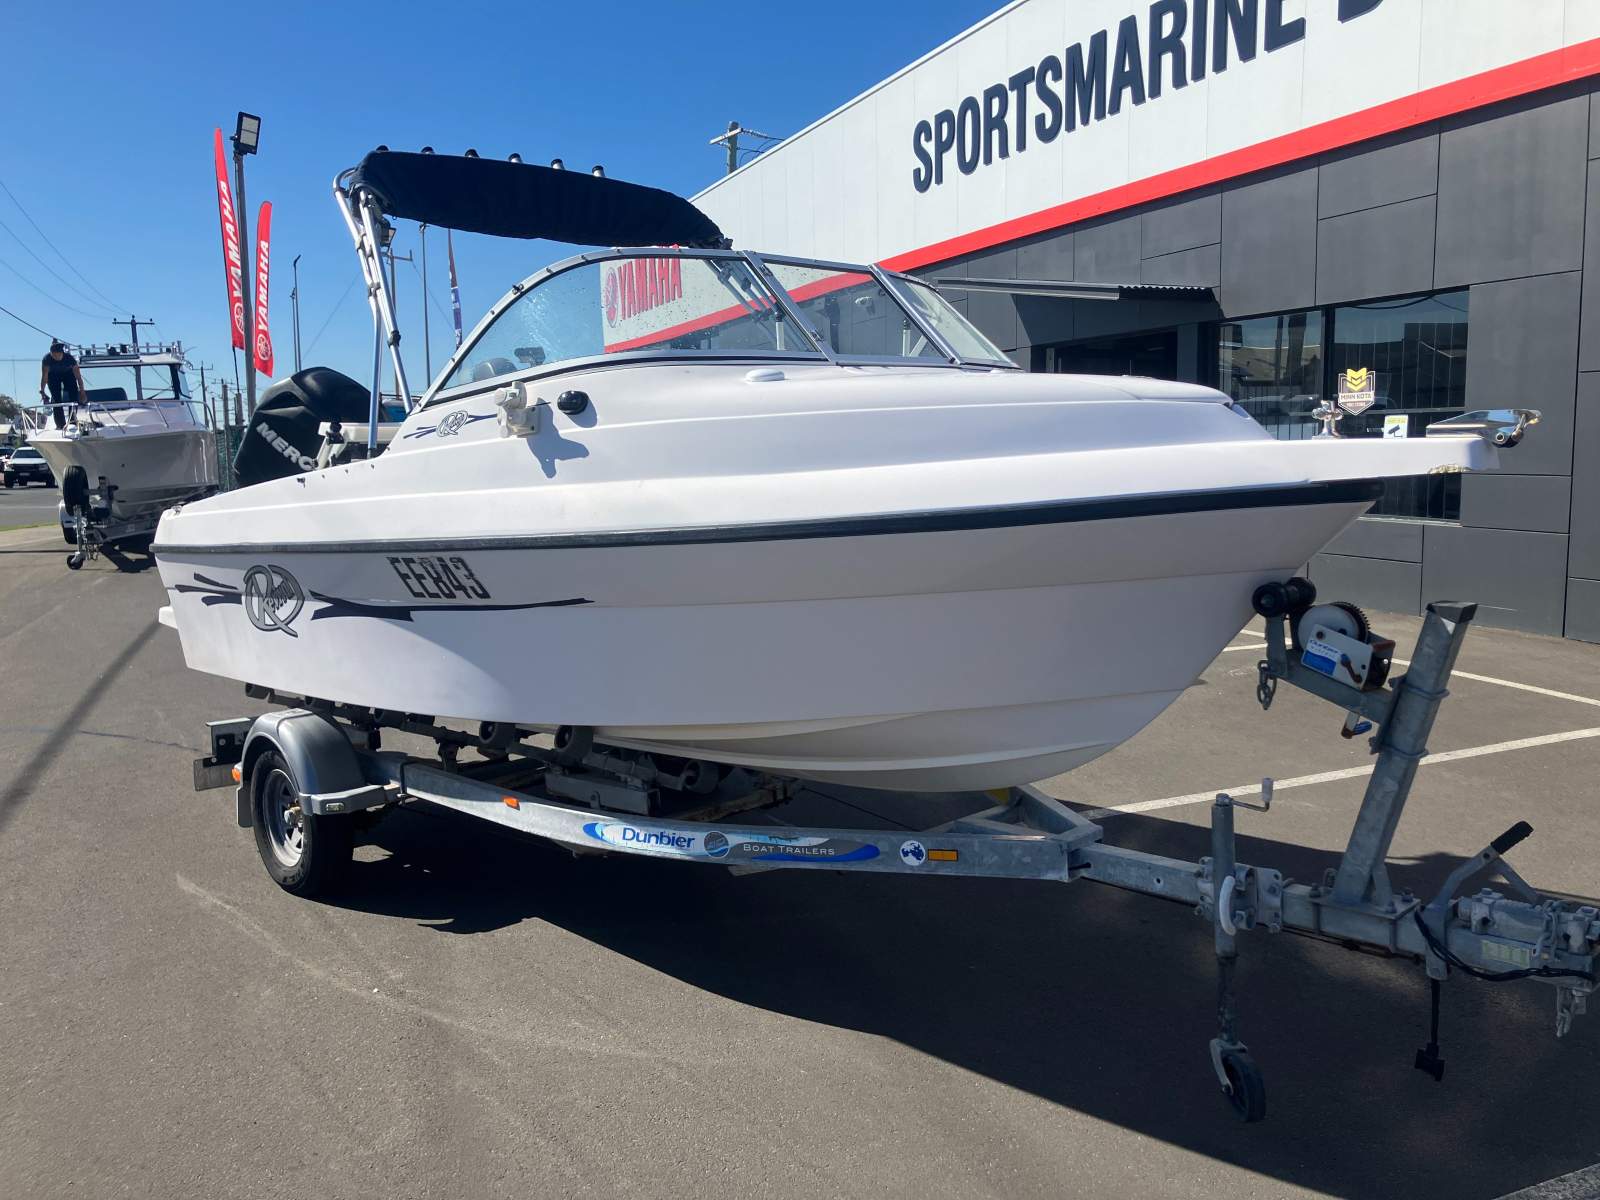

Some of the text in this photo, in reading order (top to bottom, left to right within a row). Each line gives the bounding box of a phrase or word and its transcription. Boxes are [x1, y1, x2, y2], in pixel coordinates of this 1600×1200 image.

[258, 240, 270, 331] YAMAHA
[617, 246, 683, 320] YAMAHA
[622, 827, 696, 848] Dunbier
[743, 843, 835, 855] BOAT TRAILERS
